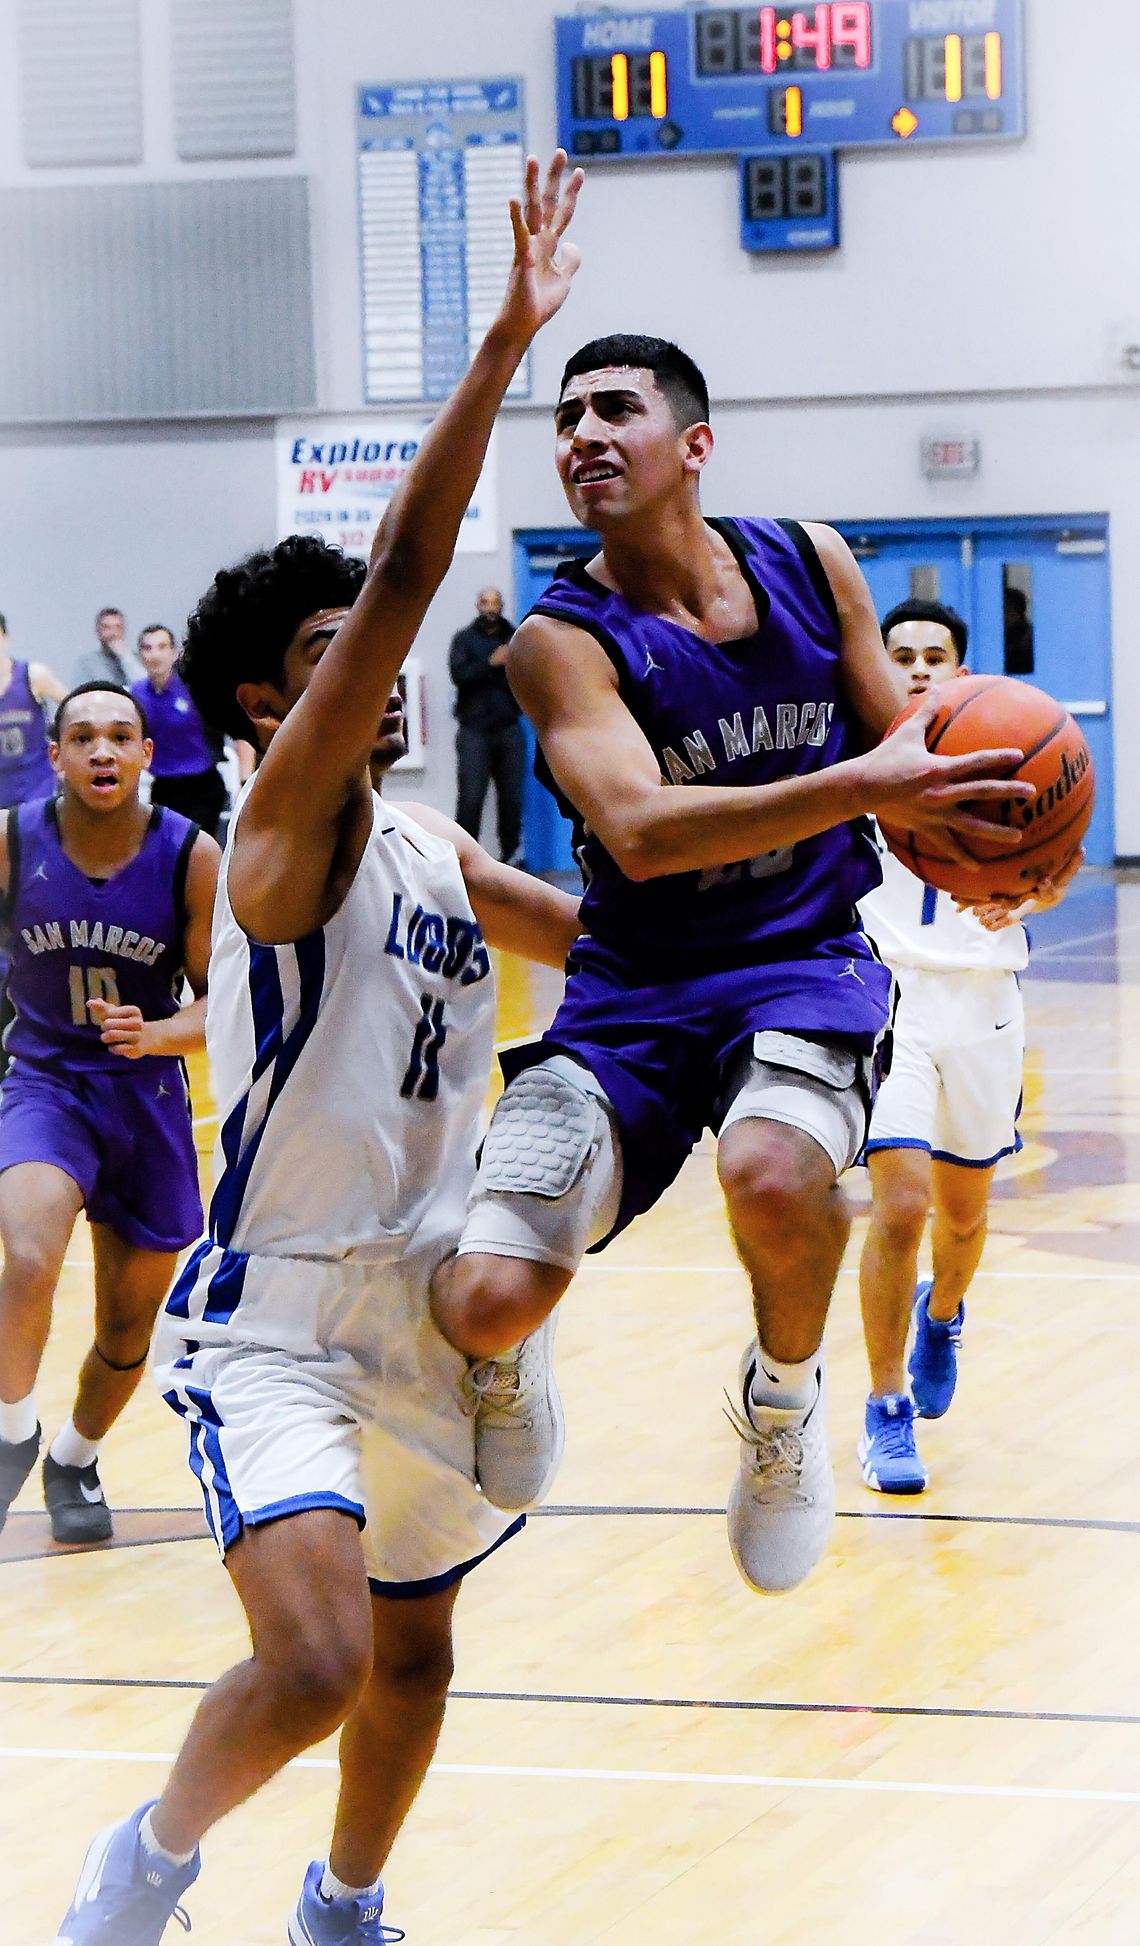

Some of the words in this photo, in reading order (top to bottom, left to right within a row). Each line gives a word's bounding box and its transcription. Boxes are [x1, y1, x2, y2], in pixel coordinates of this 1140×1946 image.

[583, 18, 655, 48] HOME
[760, 2, 870, 73] 1:49
[611, 51, 667, 121] 11
[944, 31, 1002, 102] 11
[784, 86, 802, 137] 1
[291, 437, 418, 465] Explore
[299, 469, 338, 494] RV
[660, 729, 717, 786] AN
[20, 920, 66, 956] SAN
[69, 919, 167, 967] MARCOS
[68, 965, 121, 1026] 10
[400, 991, 447, 1100] 11
